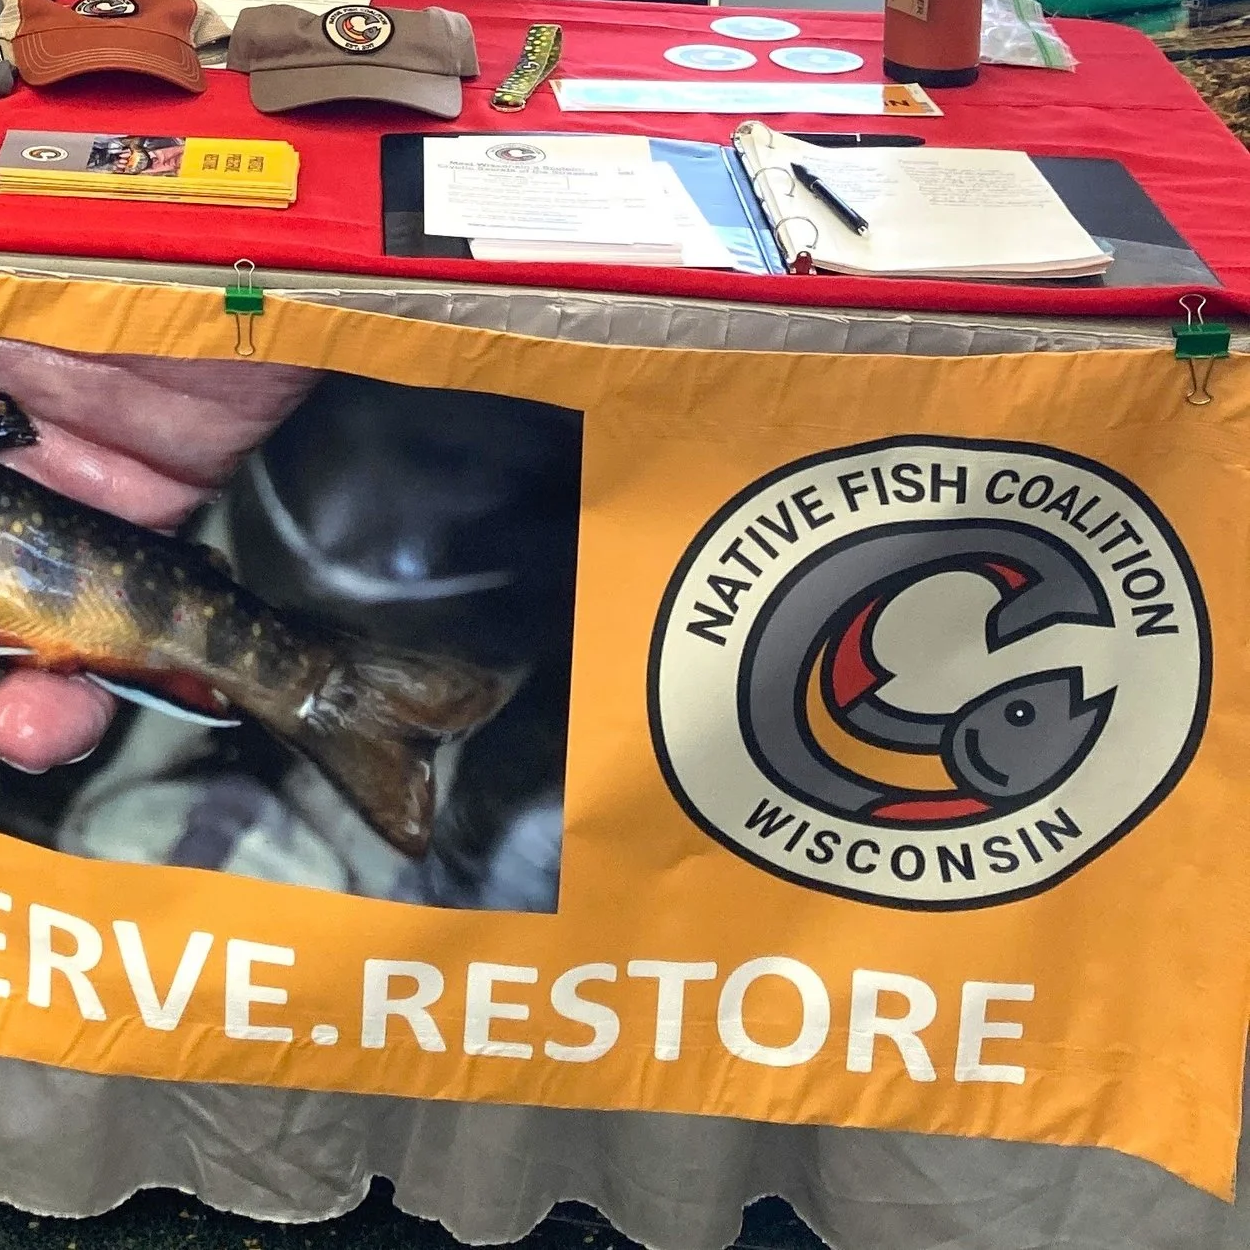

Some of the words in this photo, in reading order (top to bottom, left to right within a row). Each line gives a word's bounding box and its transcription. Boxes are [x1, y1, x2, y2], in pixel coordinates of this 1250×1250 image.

[686, 485, 836, 646] NATIVE
[837, 462, 968, 512] FISH
[985, 468, 1180, 638] COALITION
[743, 797, 1083, 883] WISCONSIN
